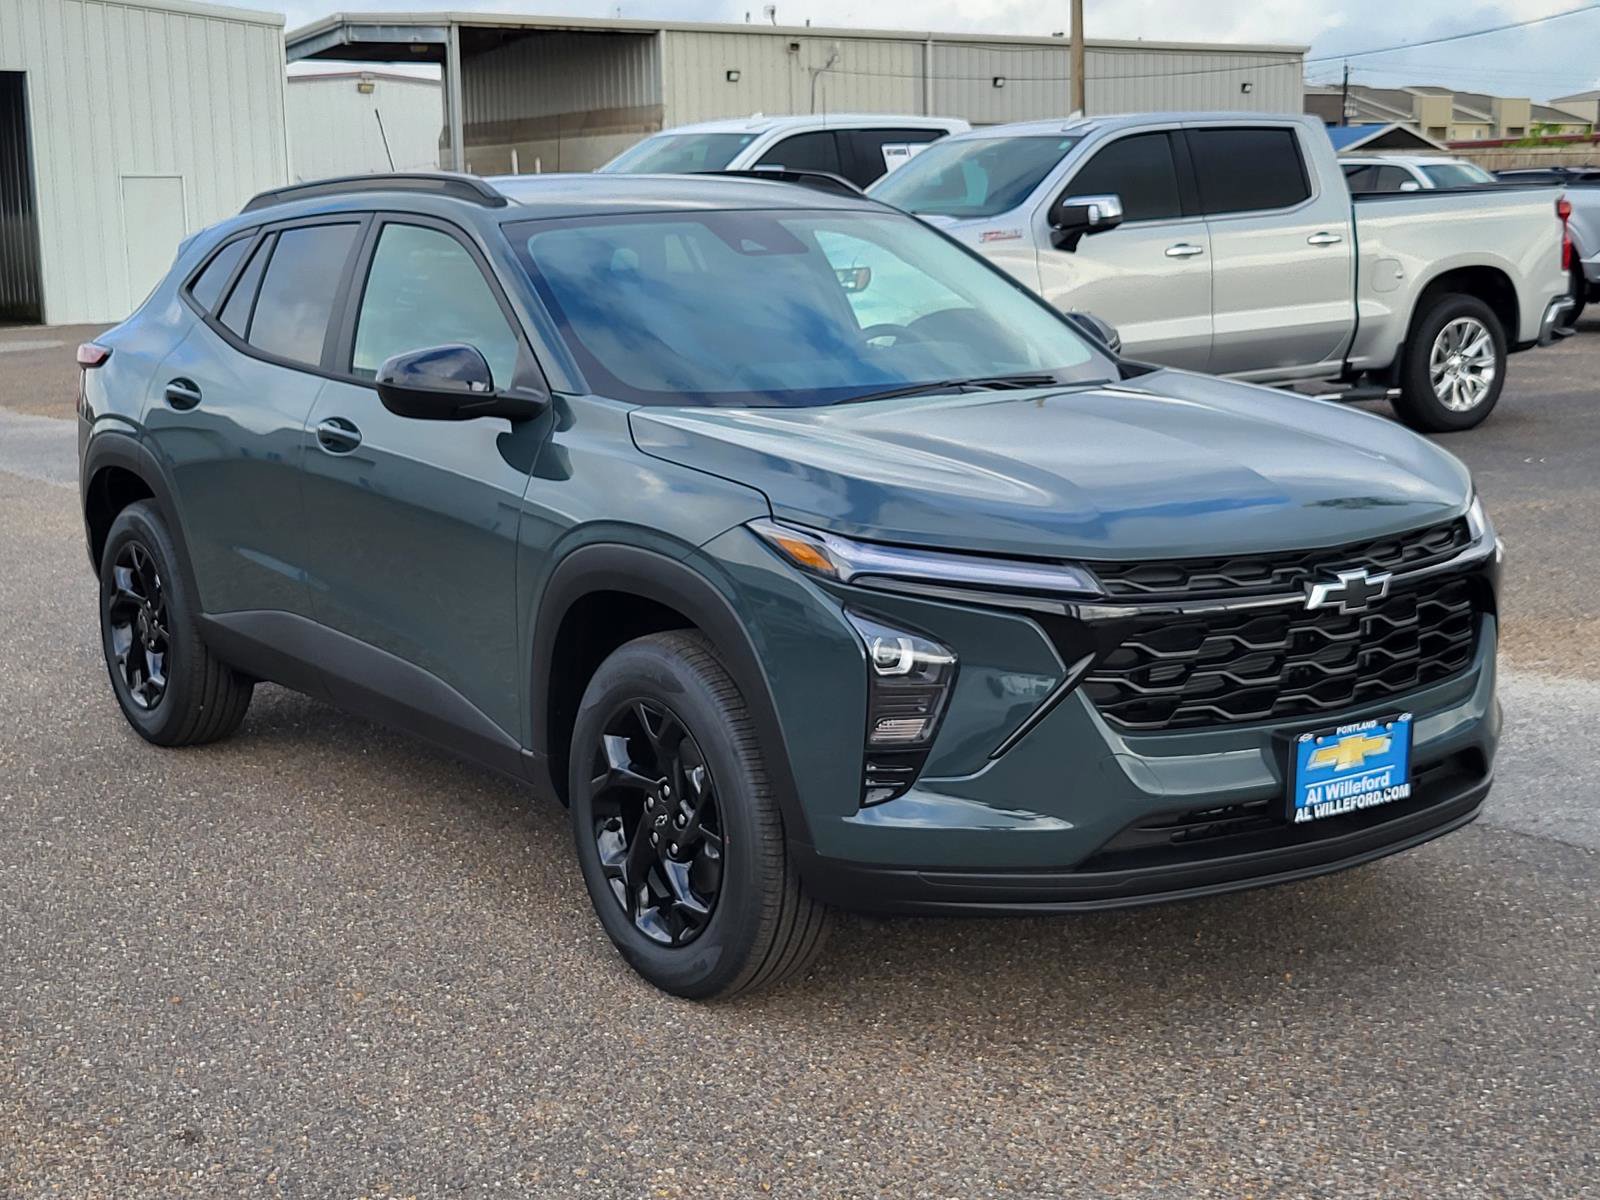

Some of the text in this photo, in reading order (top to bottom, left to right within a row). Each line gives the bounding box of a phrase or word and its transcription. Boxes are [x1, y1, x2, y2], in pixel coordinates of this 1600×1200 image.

[1336, 720, 1377, 735] PORTLAND
[1294, 783, 1411, 823] AL WILLEFORD.COM
[1305, 771, 1391, 805] Al Willeford
